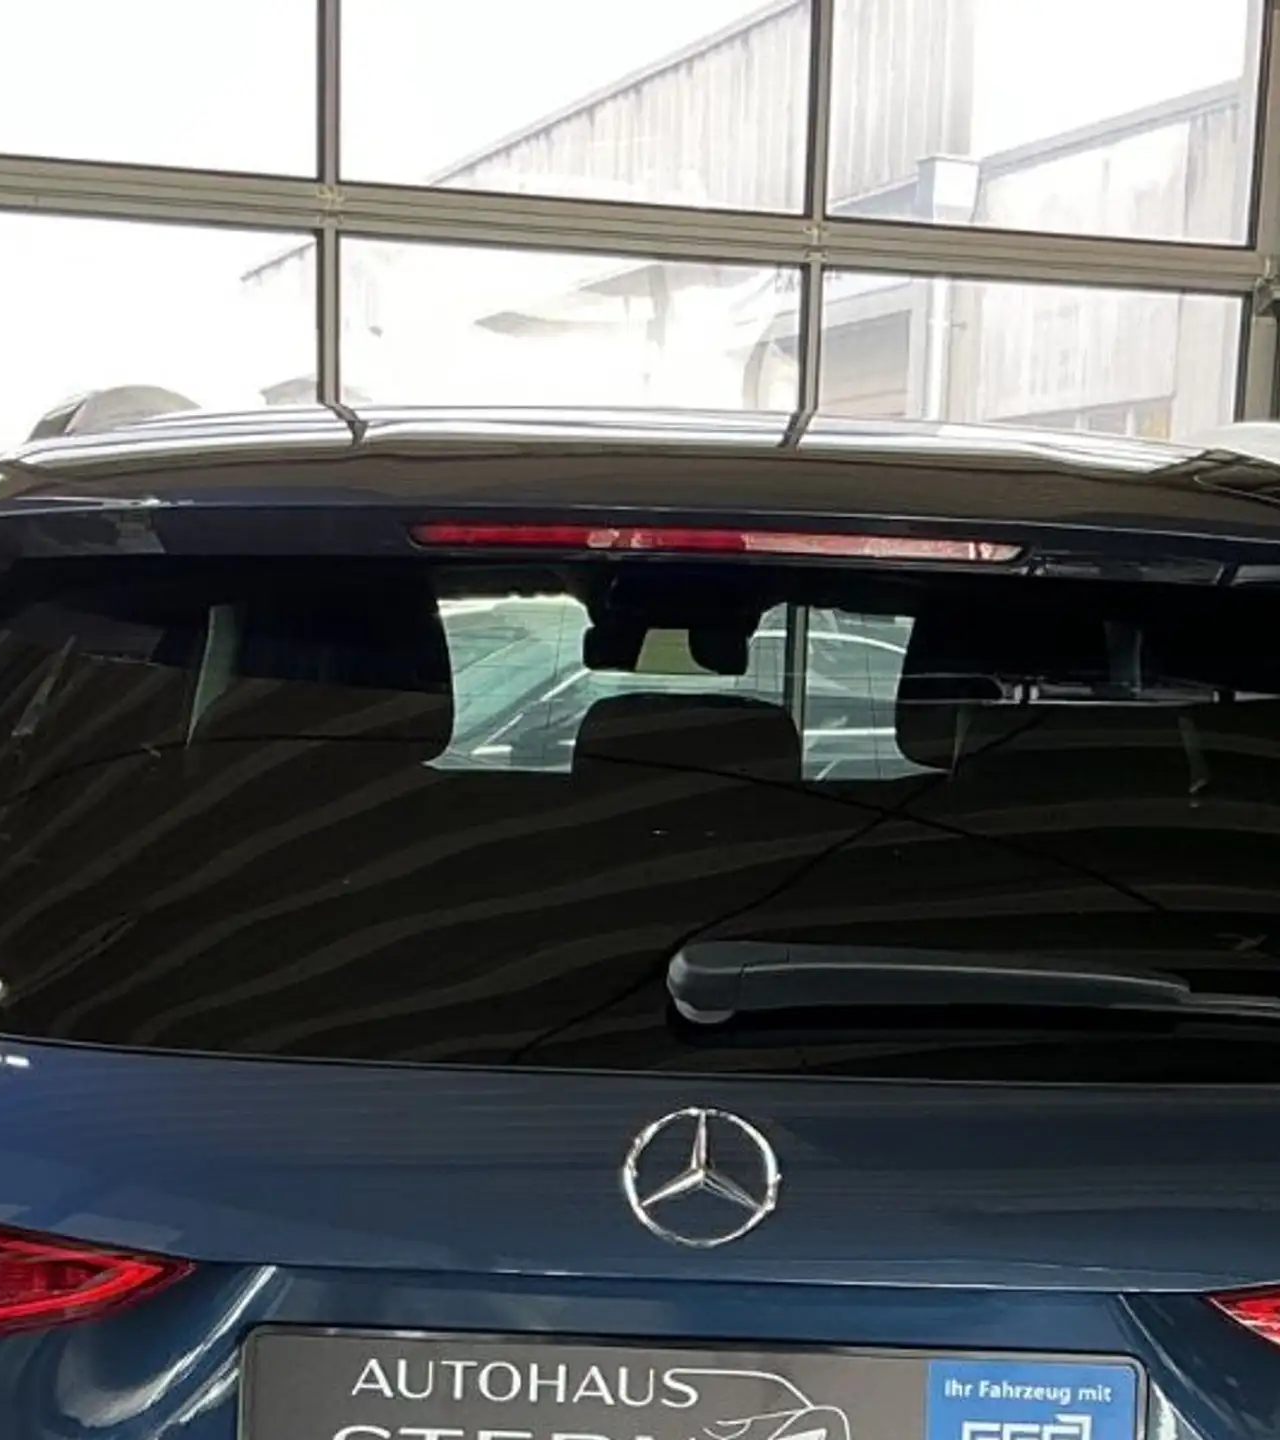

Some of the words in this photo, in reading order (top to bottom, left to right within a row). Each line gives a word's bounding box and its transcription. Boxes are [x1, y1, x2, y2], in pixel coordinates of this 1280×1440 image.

[351, 1358, 699, 1408] AUTOHAUS
[944, 1379, 972, 1398] Ihr
[978, 1379, 1072, 1405] Fahrzeug
[1078, 1384, 1112, 1402] mit
